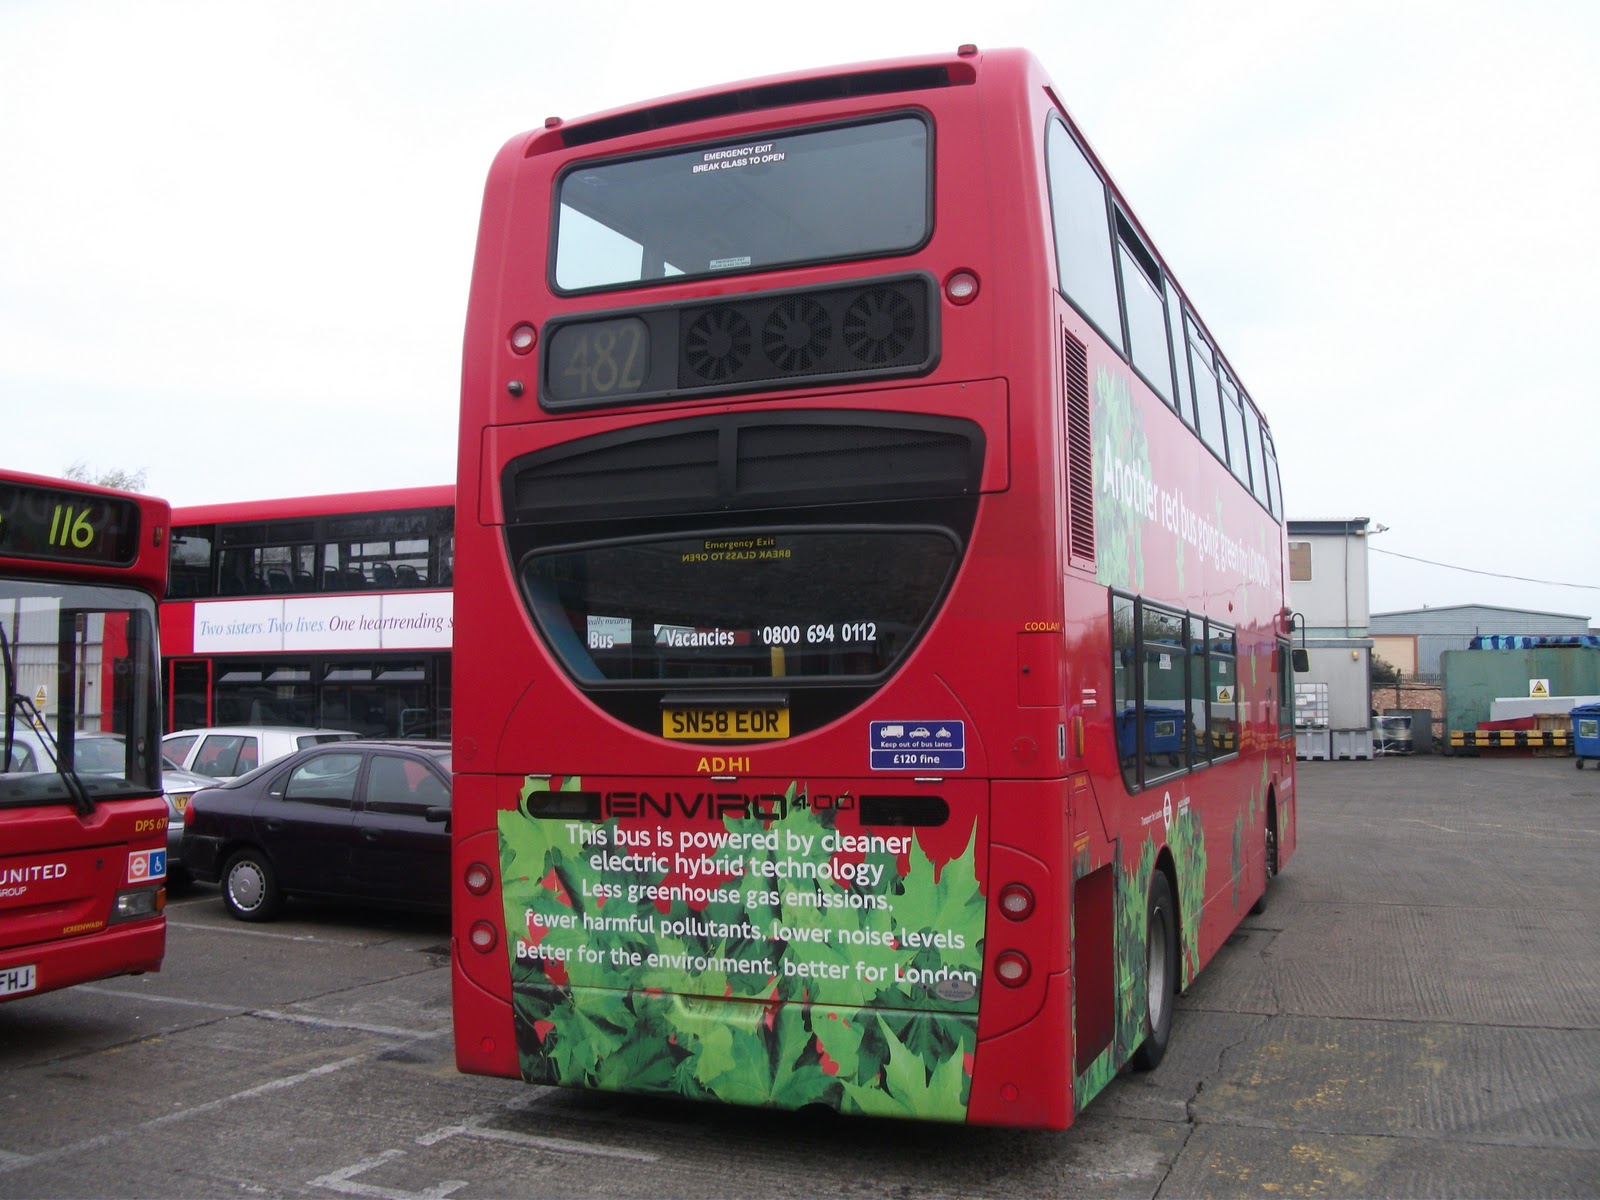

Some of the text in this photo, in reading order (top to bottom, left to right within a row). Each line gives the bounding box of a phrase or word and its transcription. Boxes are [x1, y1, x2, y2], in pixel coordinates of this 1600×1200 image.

[693, 164, 719, 173] BREAK
[721, 159, 747, 169] GLASS
[762, 153, 785, 163] OPEN
[704, 144, 772, 161] EMERGENCY EXIT
[563, 324, 642, 393] 482
[1103, 434, 1158, 522] Another
[1161, 488, 1178, 534] red
[1180, 492, 1197, 546] bus
[1198, 513, 1220, 572] going
[48, 504, 95, 548] 116
[705, 538, 774, 549] Emergency Exit
[200, 621, 223, 636] Two
[267, 617, 293, 633] Two
[329, 615, 355, 631] One
[359, 612, 444, 632] heartrending
[589, 622, 877, 649] Bus Vacancies 0800 694 0112
[671, 710, 779, 733] SN58 EOR
[697, 757, 750, 773] ADHI
[893, 754, 940, 764] £120 fine
[605, 792, 788, 821] ENVIRO
[135, 820, 155, 832] DPS
[566, 823, 912, 857] This bus is powered by cleaner
[0, 863, 67, 885] UNITED
[589, 852, 884, 886] electric hybrid technology
[582, 878, 893, 913] Less greenhouse gas emissions,
[63, 921, 103, 934] SCREENWASH
[524, 908, 966, 950] fewer harmful pollutants, lower noise levels
[515, 941, 978, 988] Better for the environment, better for London
